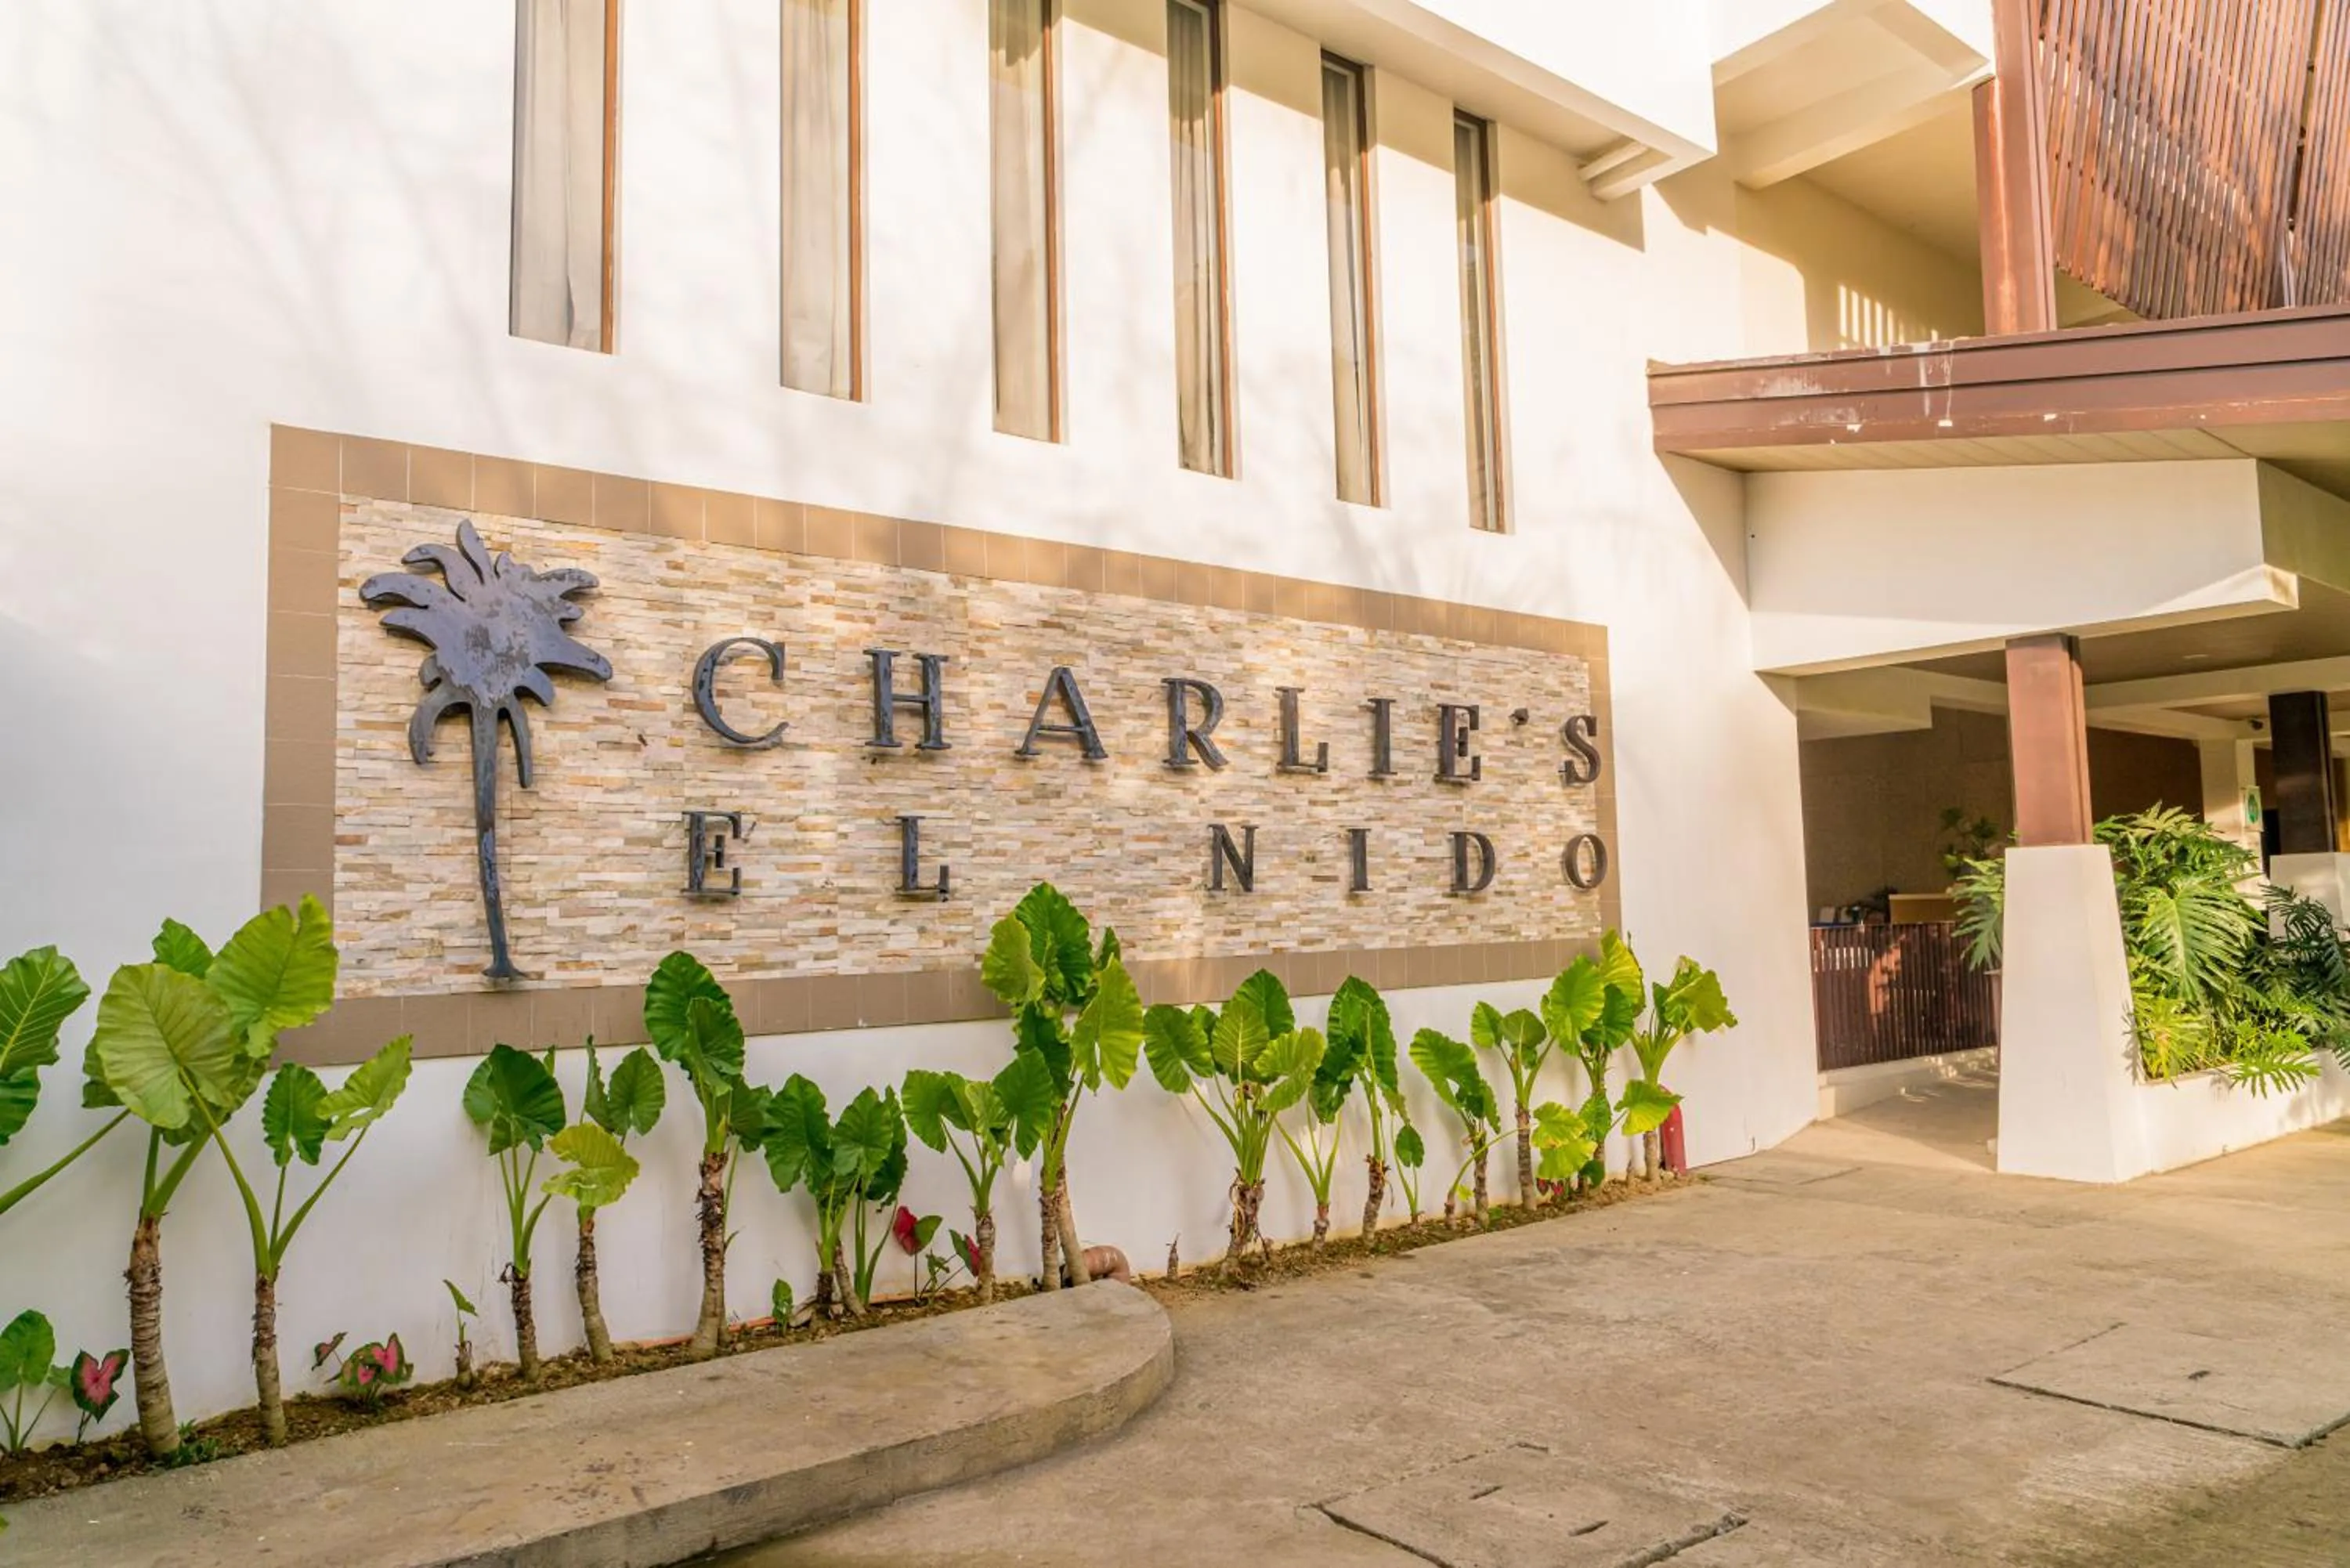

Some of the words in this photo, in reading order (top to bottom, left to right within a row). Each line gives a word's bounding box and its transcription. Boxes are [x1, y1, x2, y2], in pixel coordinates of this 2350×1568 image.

[693, 637, 1600, 783] CHARLIE'S
[682, 811, 949, 896] EL
[1208, 823, 1607, 892] NIDO
